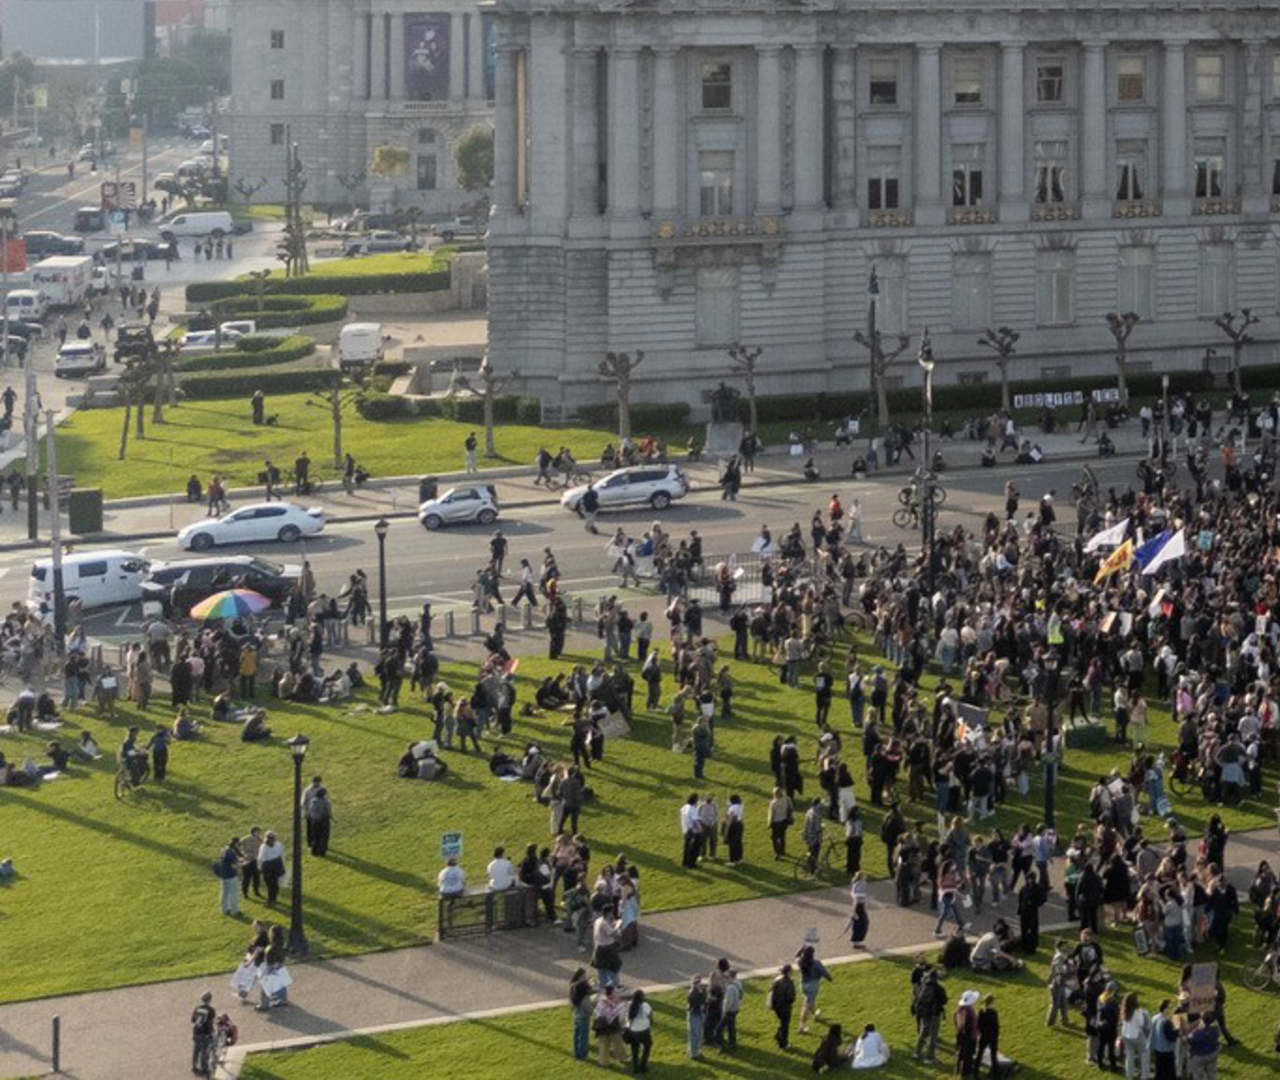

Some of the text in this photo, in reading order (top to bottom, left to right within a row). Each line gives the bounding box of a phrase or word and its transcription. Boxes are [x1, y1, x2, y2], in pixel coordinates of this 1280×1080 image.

[33, 273, 68, 283] FedEx
[1015, 389, 1119, 407] ABOLISH ICE
